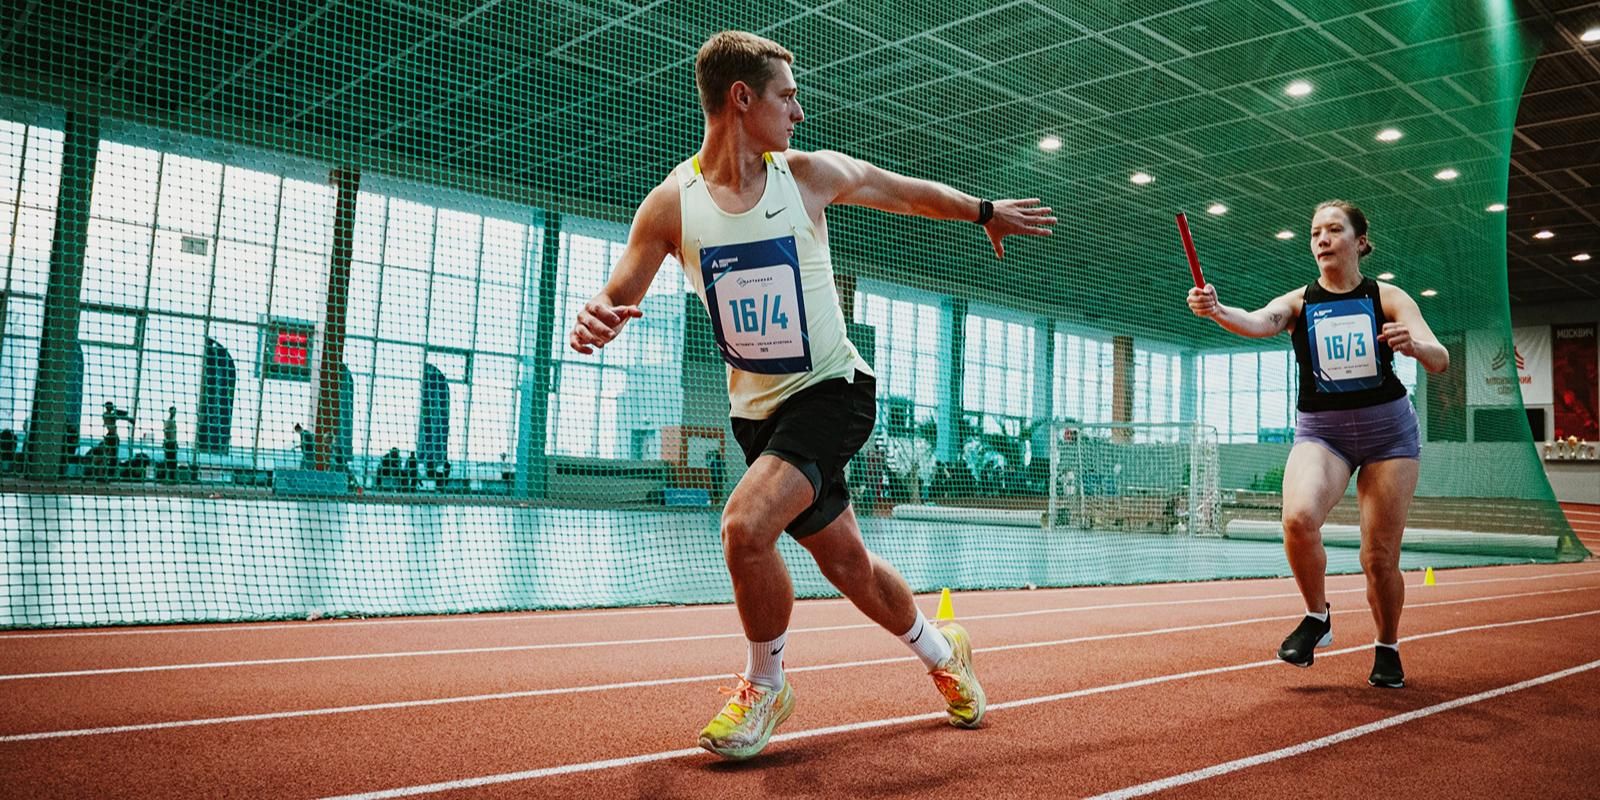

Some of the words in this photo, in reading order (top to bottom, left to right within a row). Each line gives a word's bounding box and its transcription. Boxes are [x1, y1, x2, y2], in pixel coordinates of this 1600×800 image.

[729, 294, 788, 336] 16/4
[1324, 331, 1367, 362] 16/3
[1556, 327, 1594, 339] МОСКВИЧ
